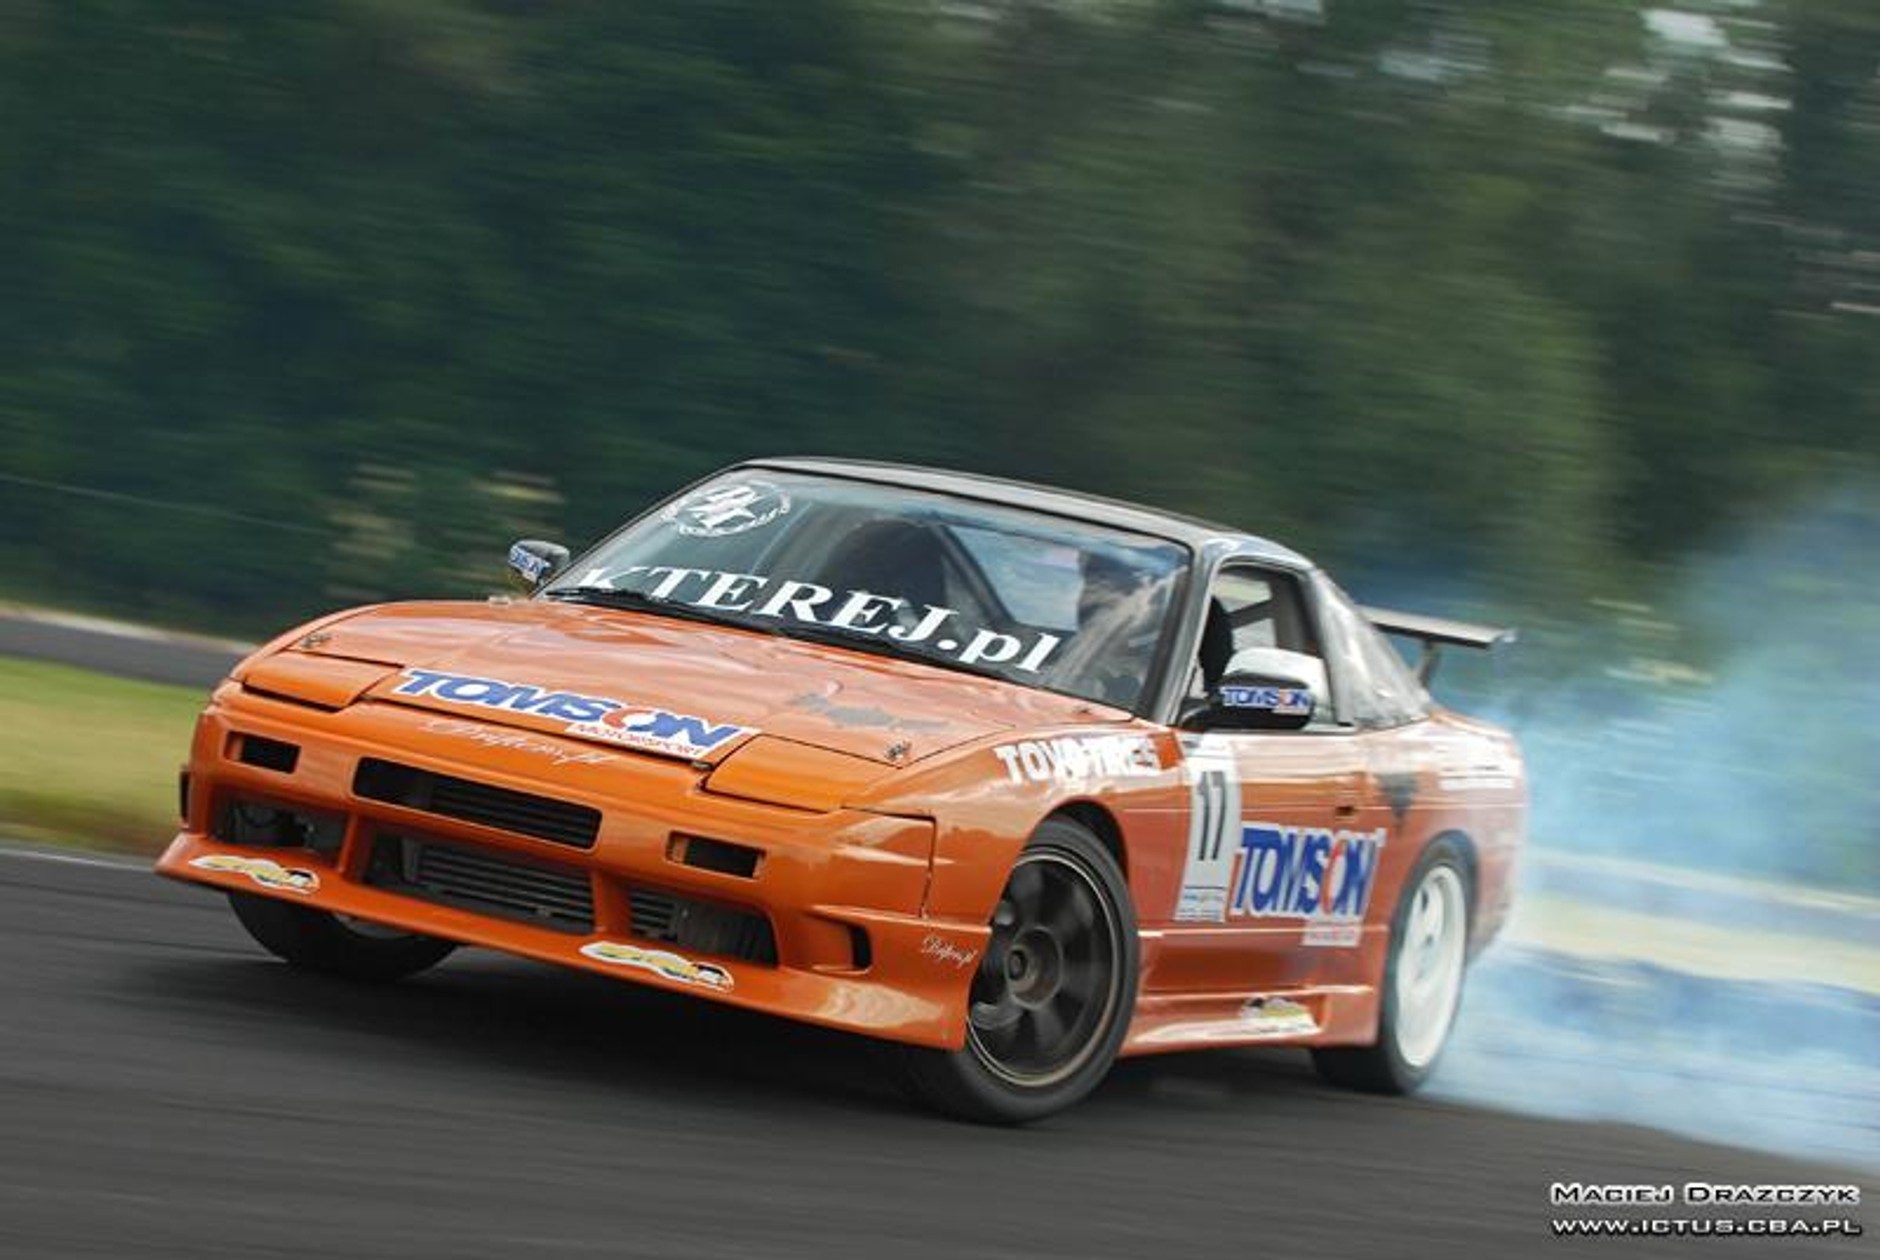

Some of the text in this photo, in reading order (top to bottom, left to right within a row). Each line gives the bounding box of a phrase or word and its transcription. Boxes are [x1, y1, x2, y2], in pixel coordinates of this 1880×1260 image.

[401, 671, 740, 748] TOMSON
[1197, 771, 1227, 861] 17
[1234, 827, 1376, 915] TOMSON
